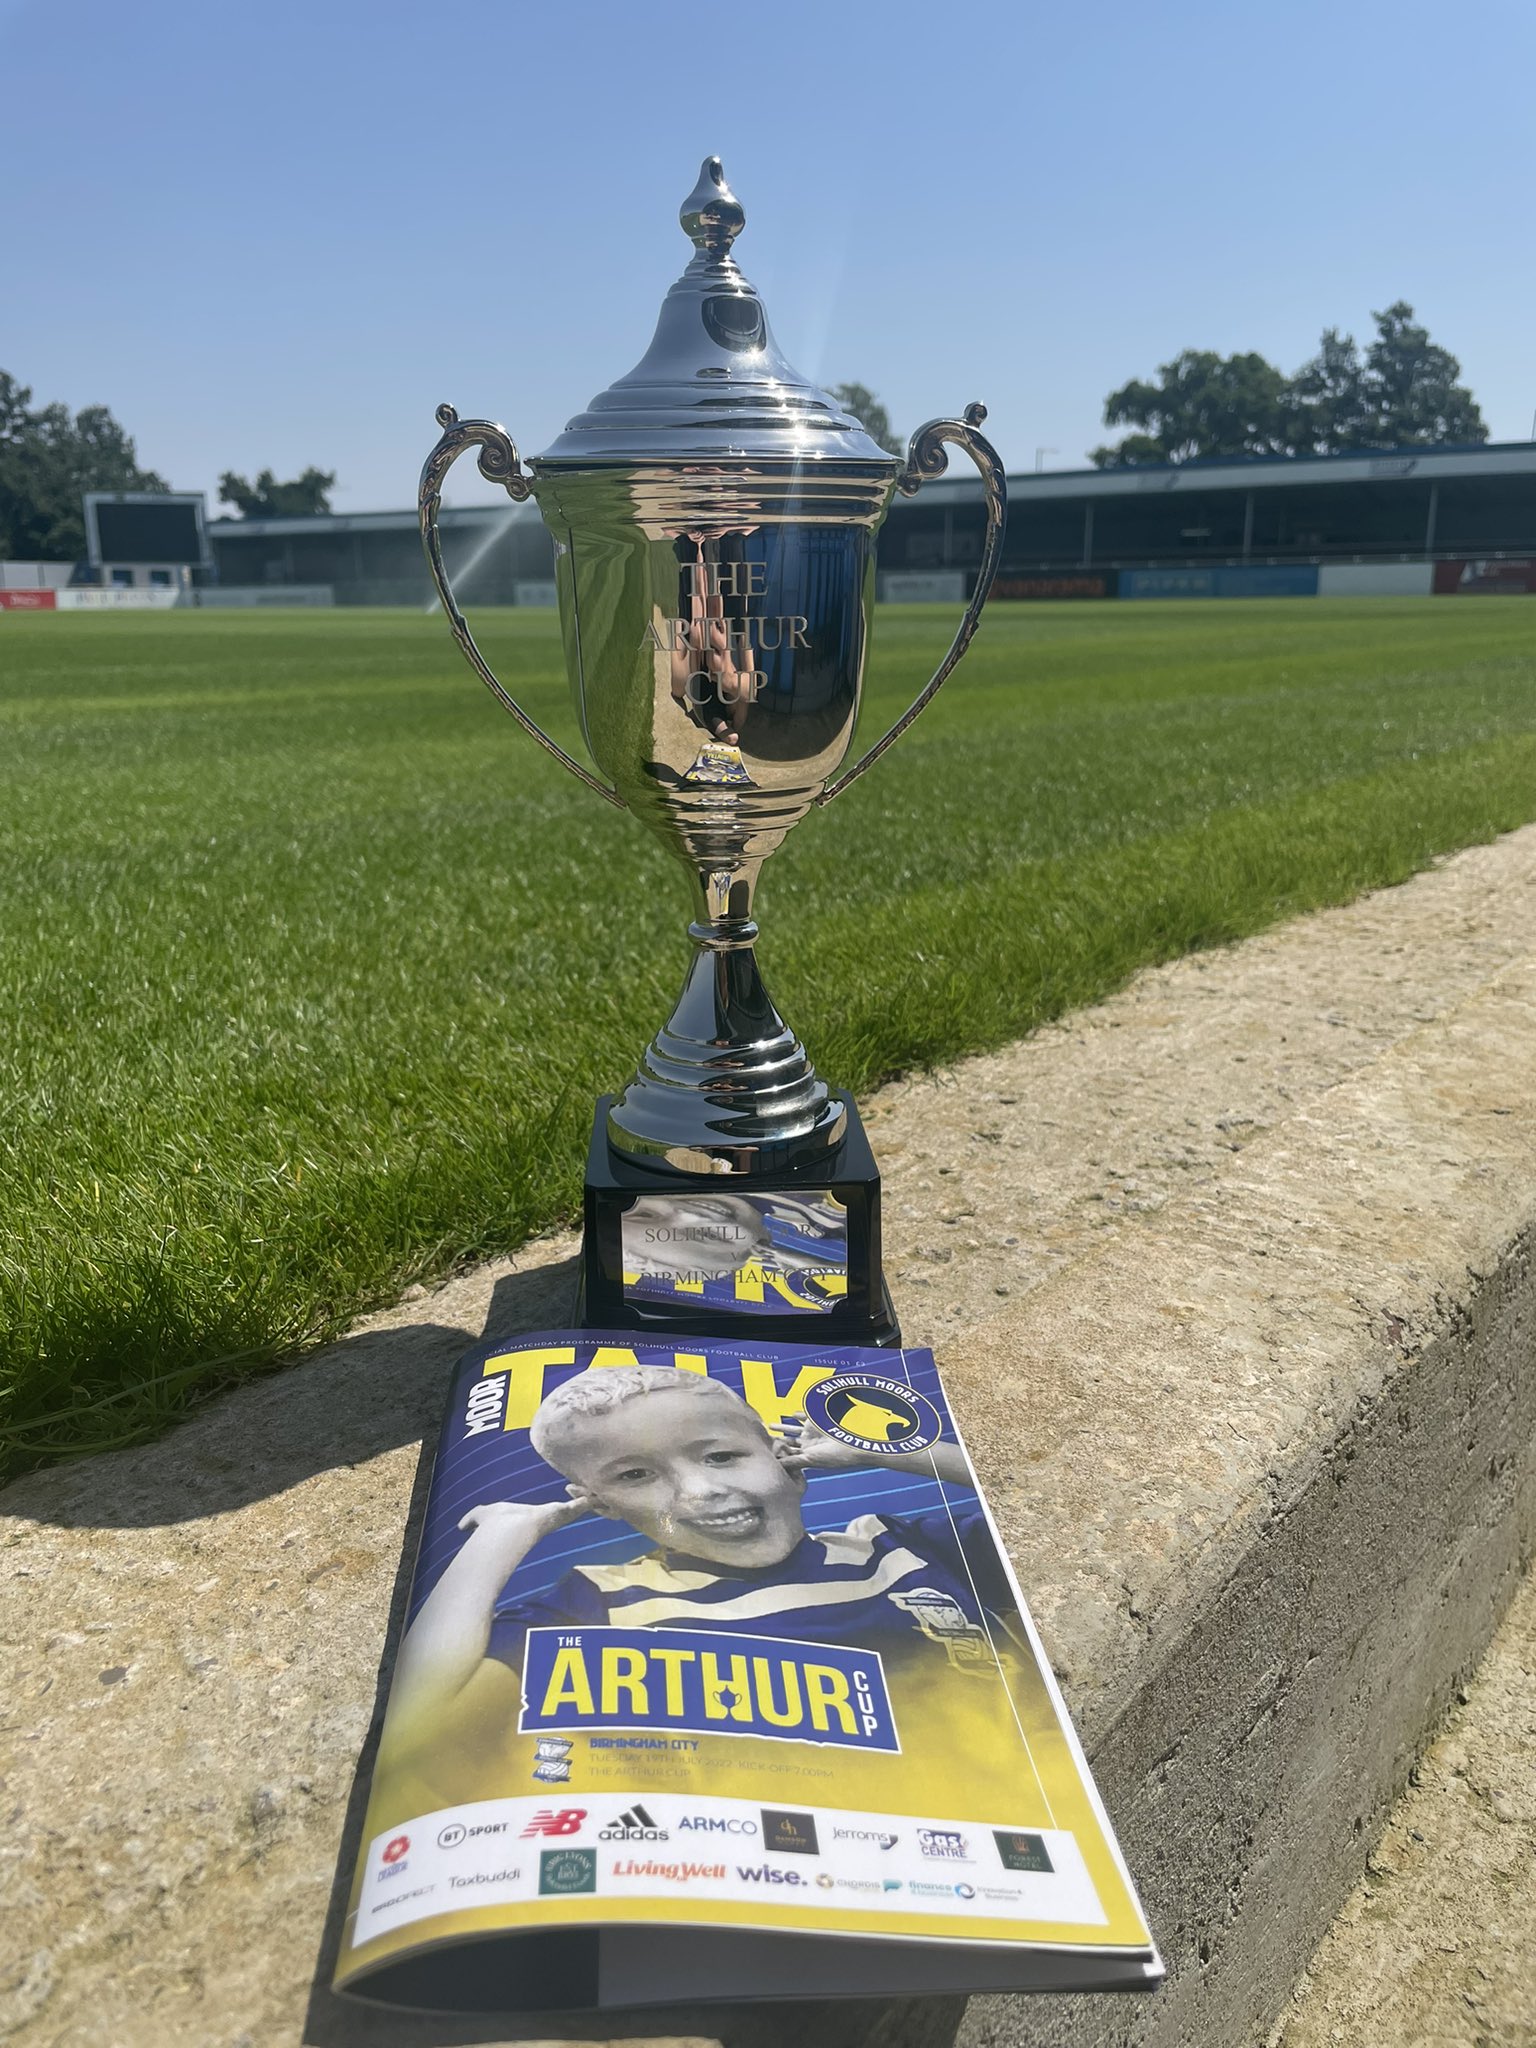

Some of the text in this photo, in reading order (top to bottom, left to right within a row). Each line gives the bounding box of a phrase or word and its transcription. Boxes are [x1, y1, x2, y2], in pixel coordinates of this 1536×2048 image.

[679, 561, 768, 598] THE
[637, 615, 813, 652] ARTHUR
[684, 670, 769, 705] CUP
[645, 1226, 746, 1243] SOLIHULL
[640, 1269, 778, 1286] BIRMINGHAM
[510, 1341, 558, 1350] MATCHDAY
[633, 1342, 675, 1350] SOLIHULL
[677, 1346, 709, 1354] MOORS
[710, 1349, 753, 1358] FOOTBALL
[816, 1376, 920, 1404] SOLIHULL MOORS
[462, 1374, 507, 1440] MOOR
[827, 1426, 930, 1453] FOOTBALL CLUB
[557, 1635, 583, 1647] THE
[540, 1646, 860, 1735] ARTHUR
[852, 1669, 879, 1738] CUP
[589, 1737, 700, 1751] BIRMINGHAM CITY
[589, 1766, 691, 1777] THE ARTHUR CUP
[443, 1822, 510, 1843] BT SPORT
[598, 1826, 670, 1841] adidas
[678, 1815, 758, 1836] ARMCO
[832, 1826, 889, 1842] Jerroms
[917, 1828, 961, 1848] Gas
[920, 1845, 968, 1859] CENTRE
[447, 1867, 521, 1889] Taxbuddi
[612, 1859, 727, 1881] LivingWell
[735, 1863, 809, 1886] wise.
